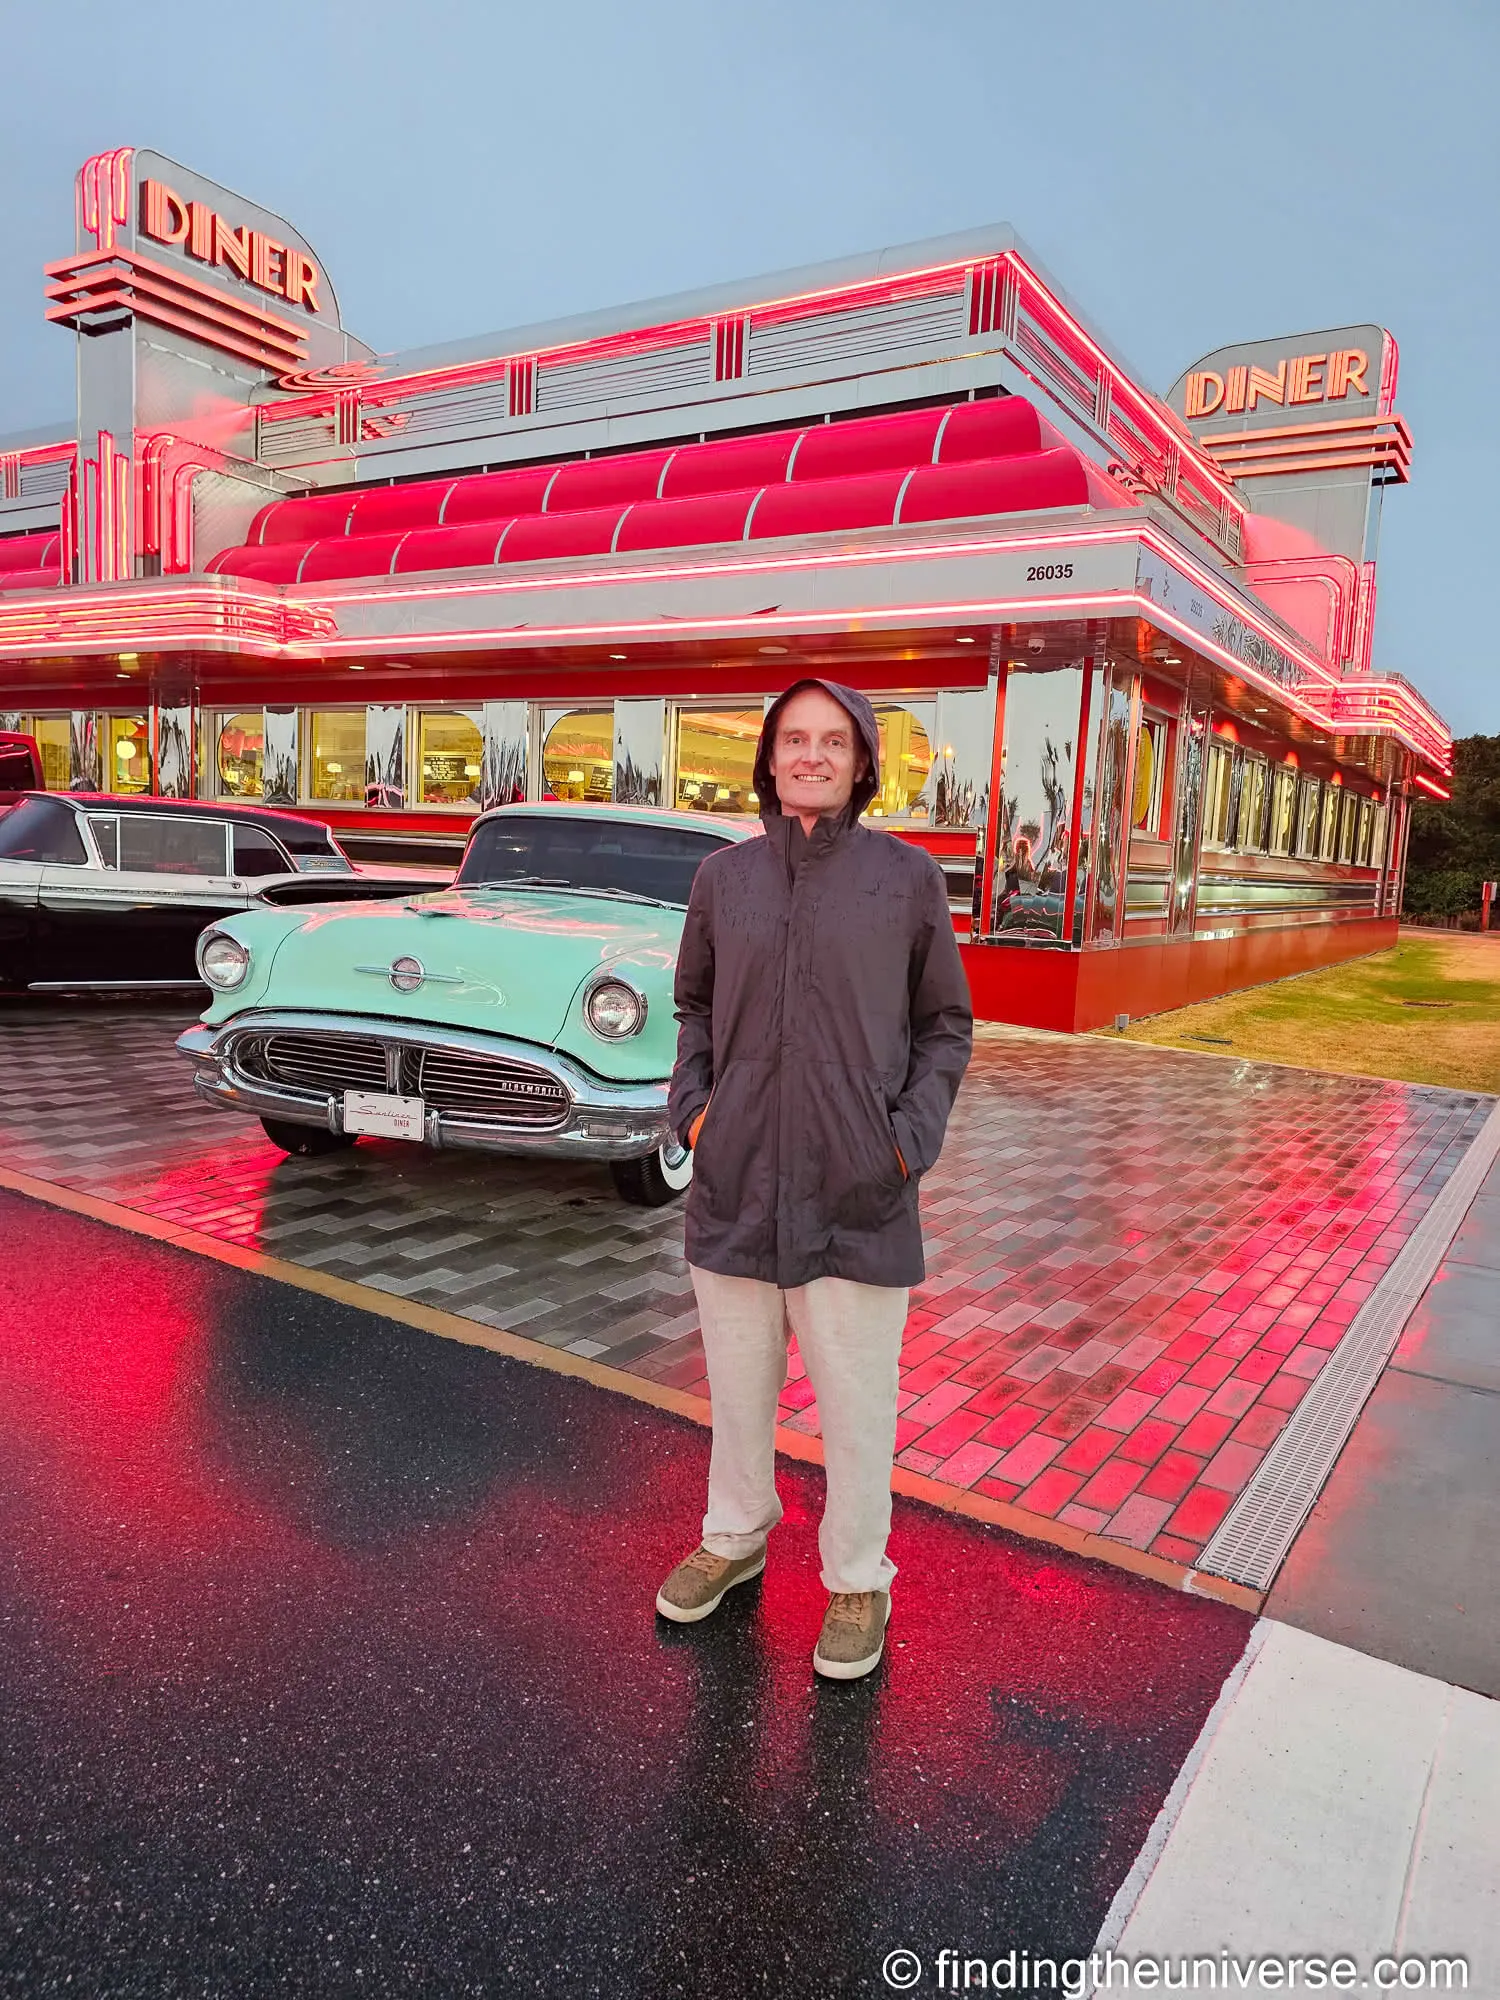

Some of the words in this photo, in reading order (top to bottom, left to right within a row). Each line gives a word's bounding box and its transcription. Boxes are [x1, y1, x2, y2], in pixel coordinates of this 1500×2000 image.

[140, 178, 321, 312] DINER
[1185, 348, 1370, 419] DINER
[1026, 563, 1074, 581] 26035
[501, 1082, 564, 1097] OLDSMOBILE
[393, 1119, 410, 1128] DINER
